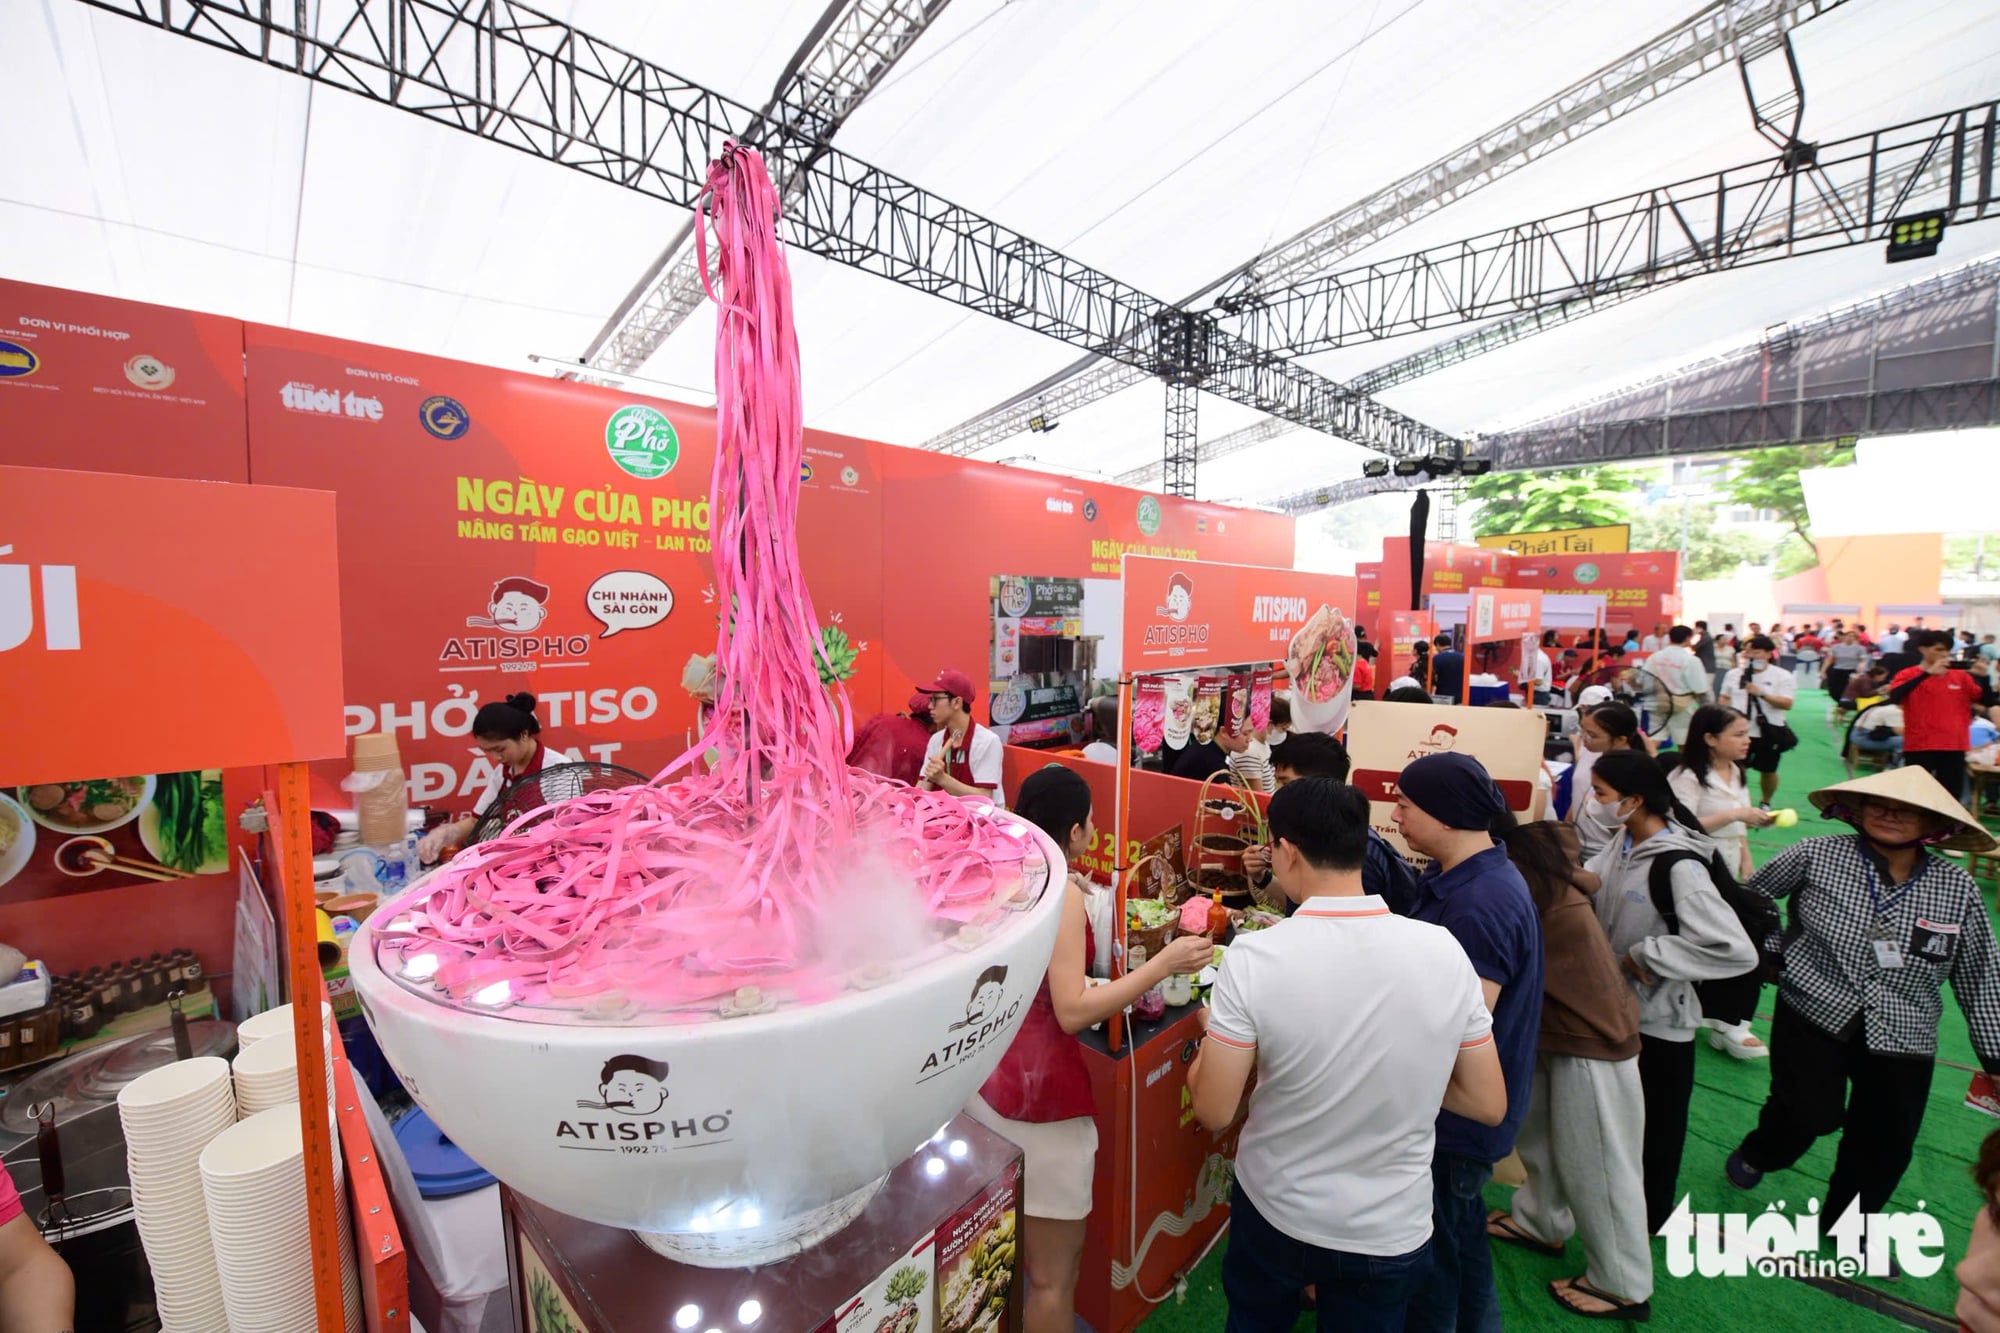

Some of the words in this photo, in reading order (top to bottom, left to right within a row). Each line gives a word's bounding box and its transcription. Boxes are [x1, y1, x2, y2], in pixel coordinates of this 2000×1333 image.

[19, 316, 50, 329] ĐƠN
[53, 322, 66, 334] VỊ
[69, 324, 100, 337] PHỐI
[103, 330, 130, 341] HỢP
[345, 367, 368, 378] ĐƠN
[613, 415, 670, 452] Phở
[457, 476, 564, 518] NGÀY
[574, 483, 642, 525] CỦA
[457, 519, 514, 541] NÂNG
[519, 521, 557, 543] TẦM
[562, 528, 600, 548] GẠO
[604, 529, 639, 550] VIỆT
[655, 535, 685, 552] LAN
[592, 591, 616, 601] CHI
[620, 589, 668, 602] NHÁNH
[603, 602, 625, 614] SÀI
[629, 603, 658, 614] GÒN
[1252, 595, 1307, 622] ATISPHO
[439, 635, 589, 660] ATISPHO
[1144, 624, 1209, 645] ATISPHO
[538, 686, 658, 728] TISO
[920, 997, 1021, 1073] ATISPHO
[556, 1112, 732, 1141] ATISPHO
[620, 1145, 649, 1154] 1992
